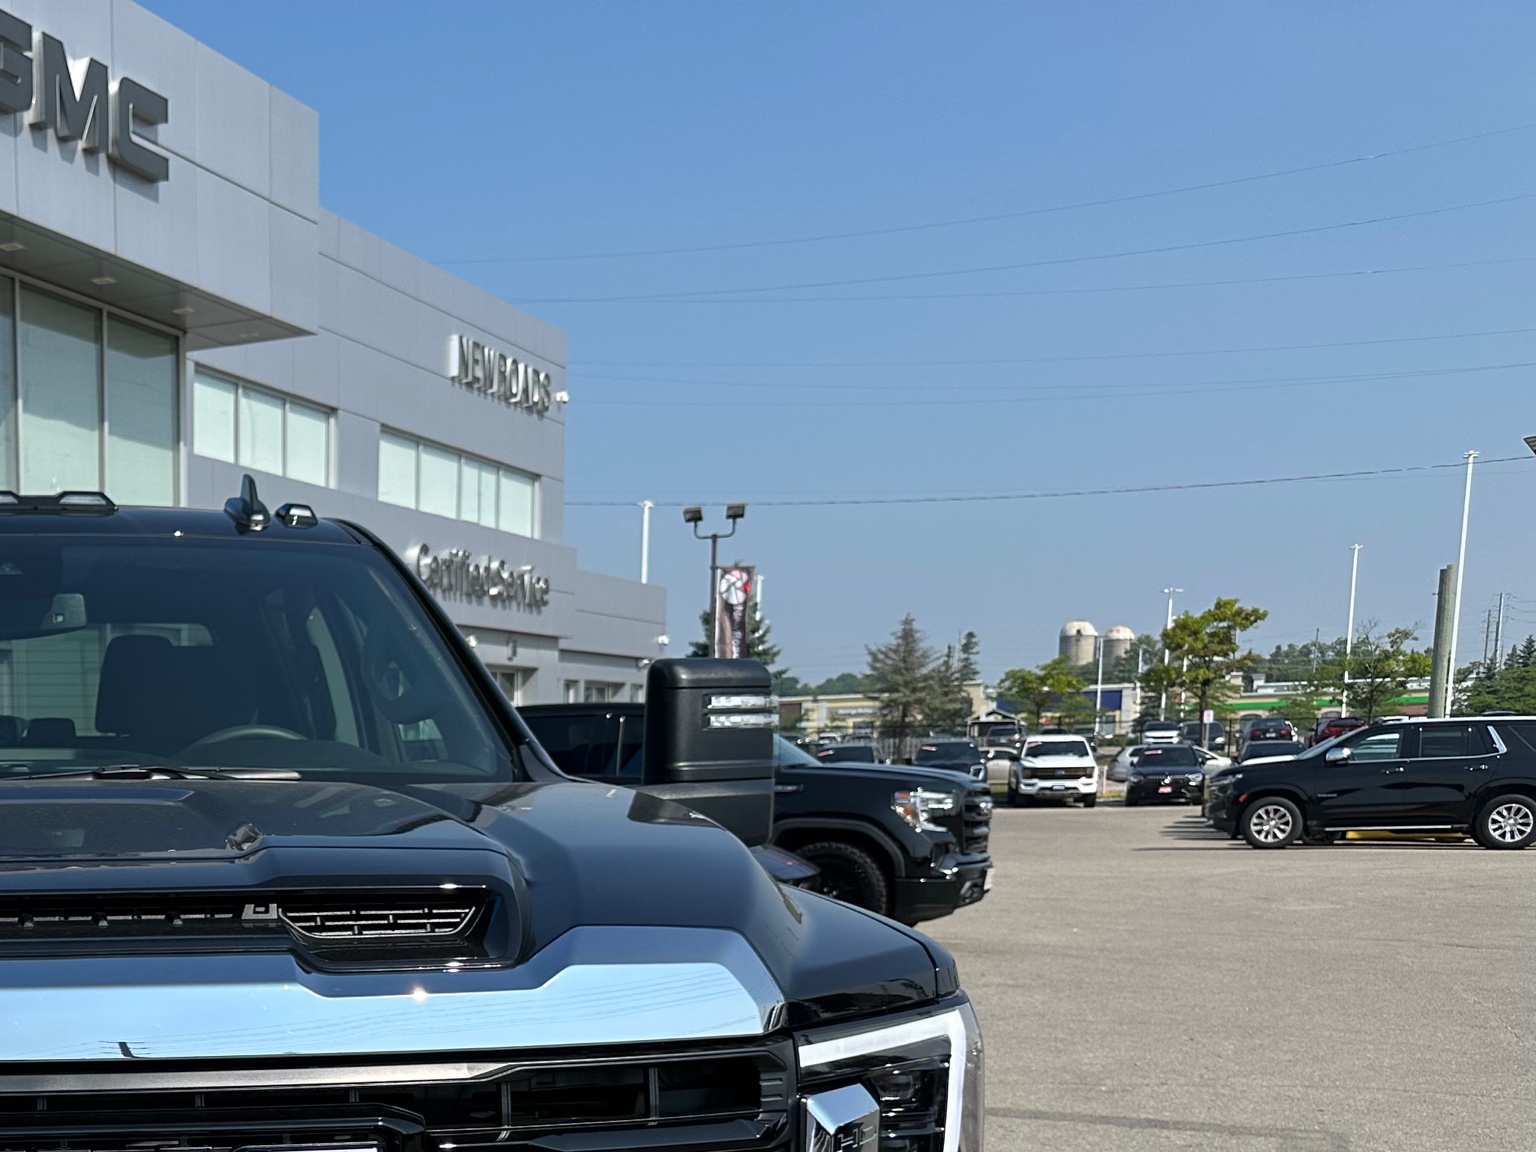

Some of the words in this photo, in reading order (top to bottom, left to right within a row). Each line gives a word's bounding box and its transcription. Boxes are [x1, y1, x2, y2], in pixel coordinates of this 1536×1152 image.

[408, 543, 490, 598] Certified
[489, 560, 549, 606] Service
[835, 1123, 877, 1152] HD
